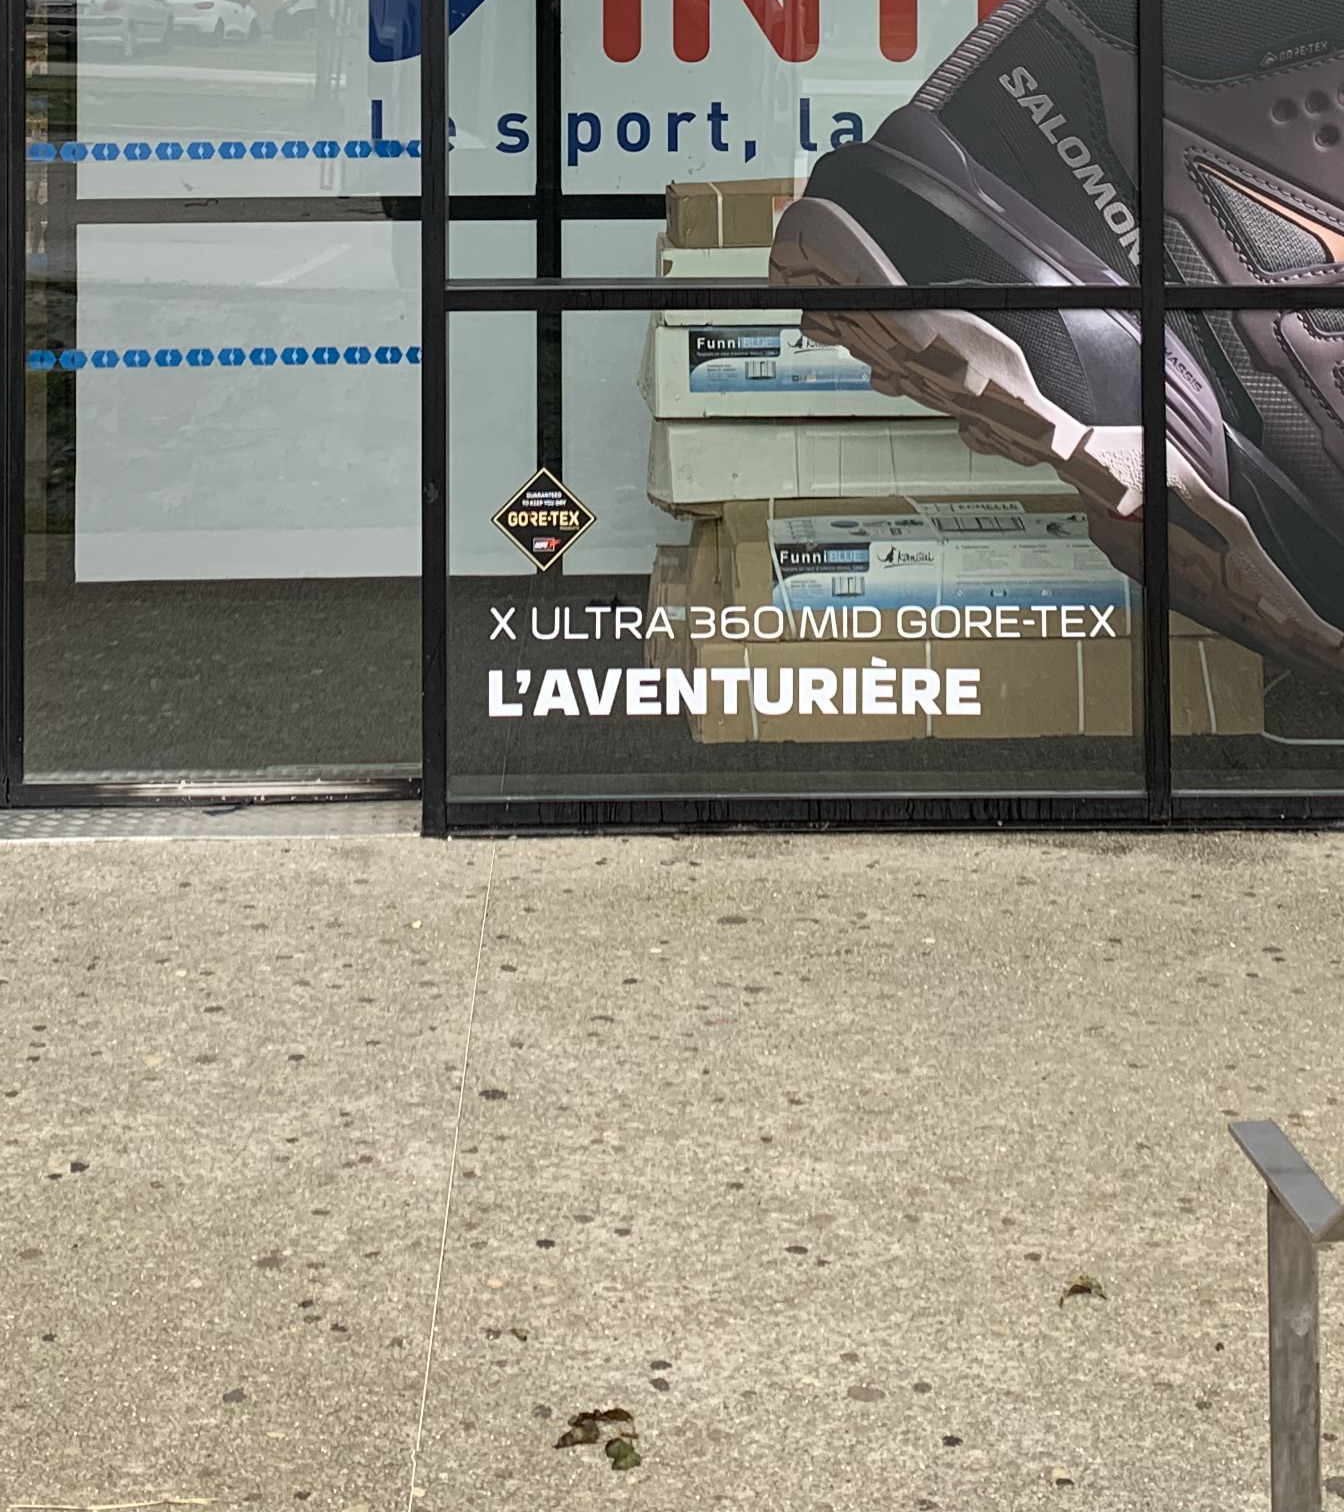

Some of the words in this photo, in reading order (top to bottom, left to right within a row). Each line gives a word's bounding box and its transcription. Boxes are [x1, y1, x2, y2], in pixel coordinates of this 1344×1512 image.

[998, 65, 1141, 267] SALOMON
[489, 607, 517, 640] X
[531, 606, 675, 641] ULTRA
[690, 606, 783, 641] 360
[799, 605, 882, 640] MID
[896, 604, 1117, 639] GORE-TEX
[487, 656, 982, 716] L'AVENTURIÈRE
